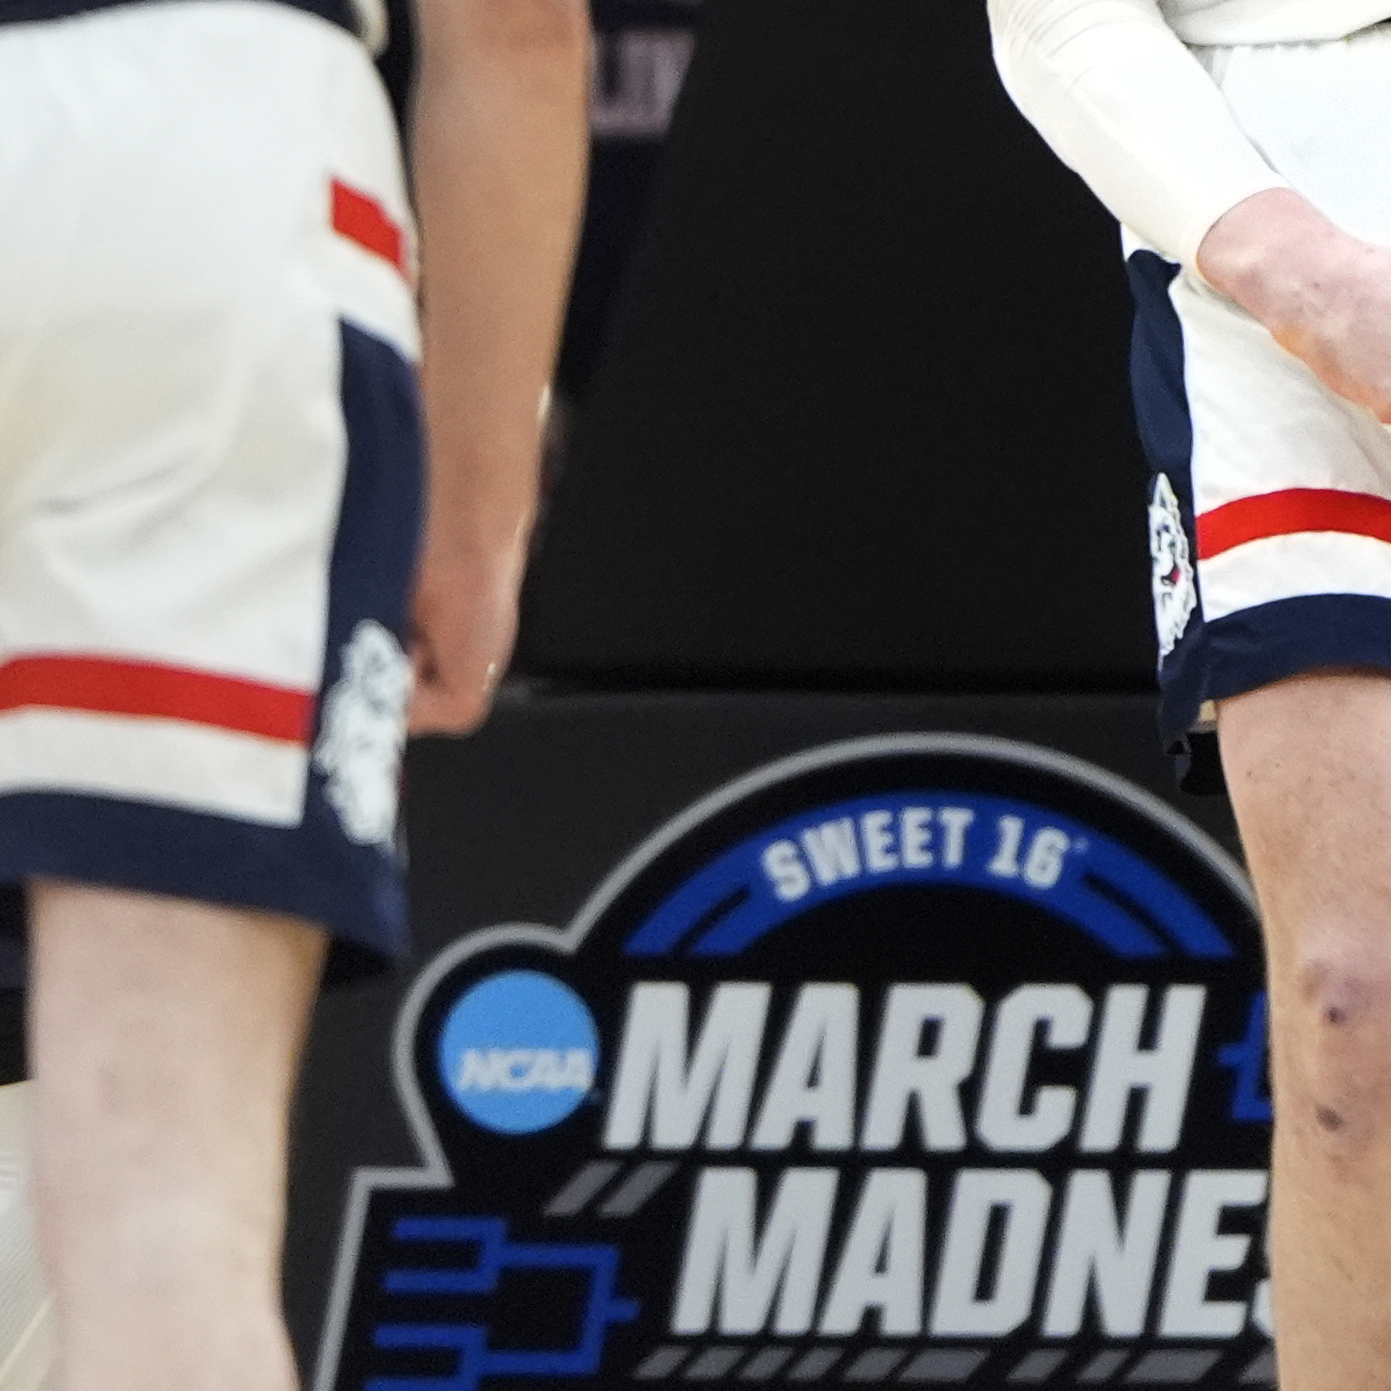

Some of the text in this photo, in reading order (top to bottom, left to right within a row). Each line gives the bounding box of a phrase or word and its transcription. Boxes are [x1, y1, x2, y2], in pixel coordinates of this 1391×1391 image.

[762, 805, 1071, 903] SWEET 16
[456, 1047, 593, 1093] NCAA
[603, 981, 1206, 1152] MARCH
[671, 1168, 1274, 1339] MADNE
